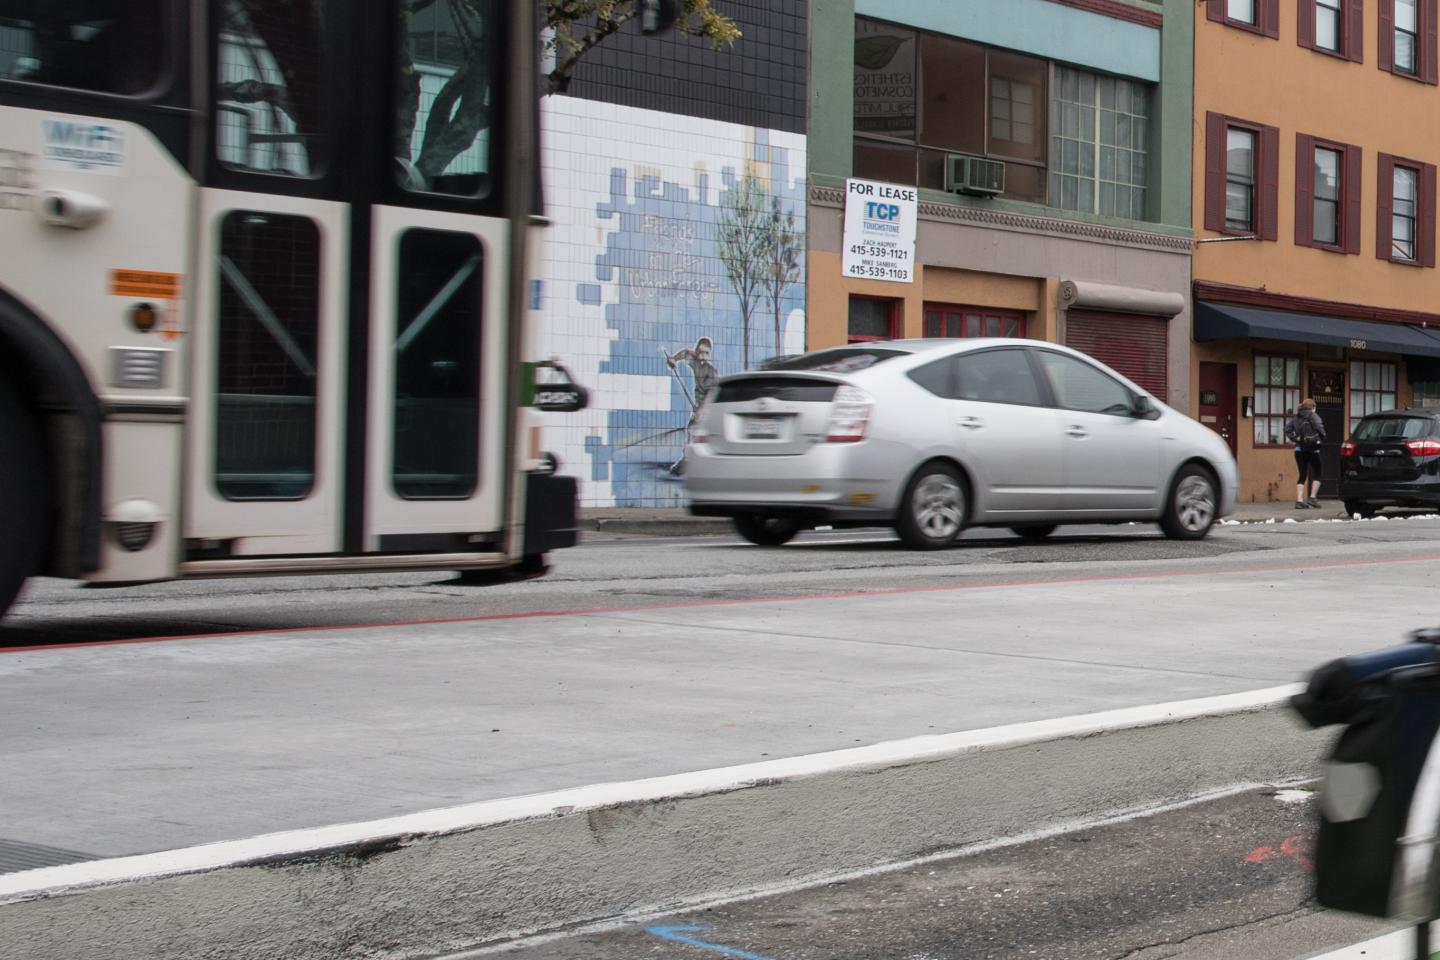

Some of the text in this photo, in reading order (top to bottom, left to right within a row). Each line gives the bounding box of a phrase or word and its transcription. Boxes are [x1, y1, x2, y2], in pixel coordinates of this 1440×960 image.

[849, 182, 915, 201] FOR LEASE
[866, 201, 900, 221] TCP
[863, 221, 900, 234] TOUCHSTONE
[850, 244, 908, 260] 415-539-1121
[849, 264, 908, 280] 415-539-1103
